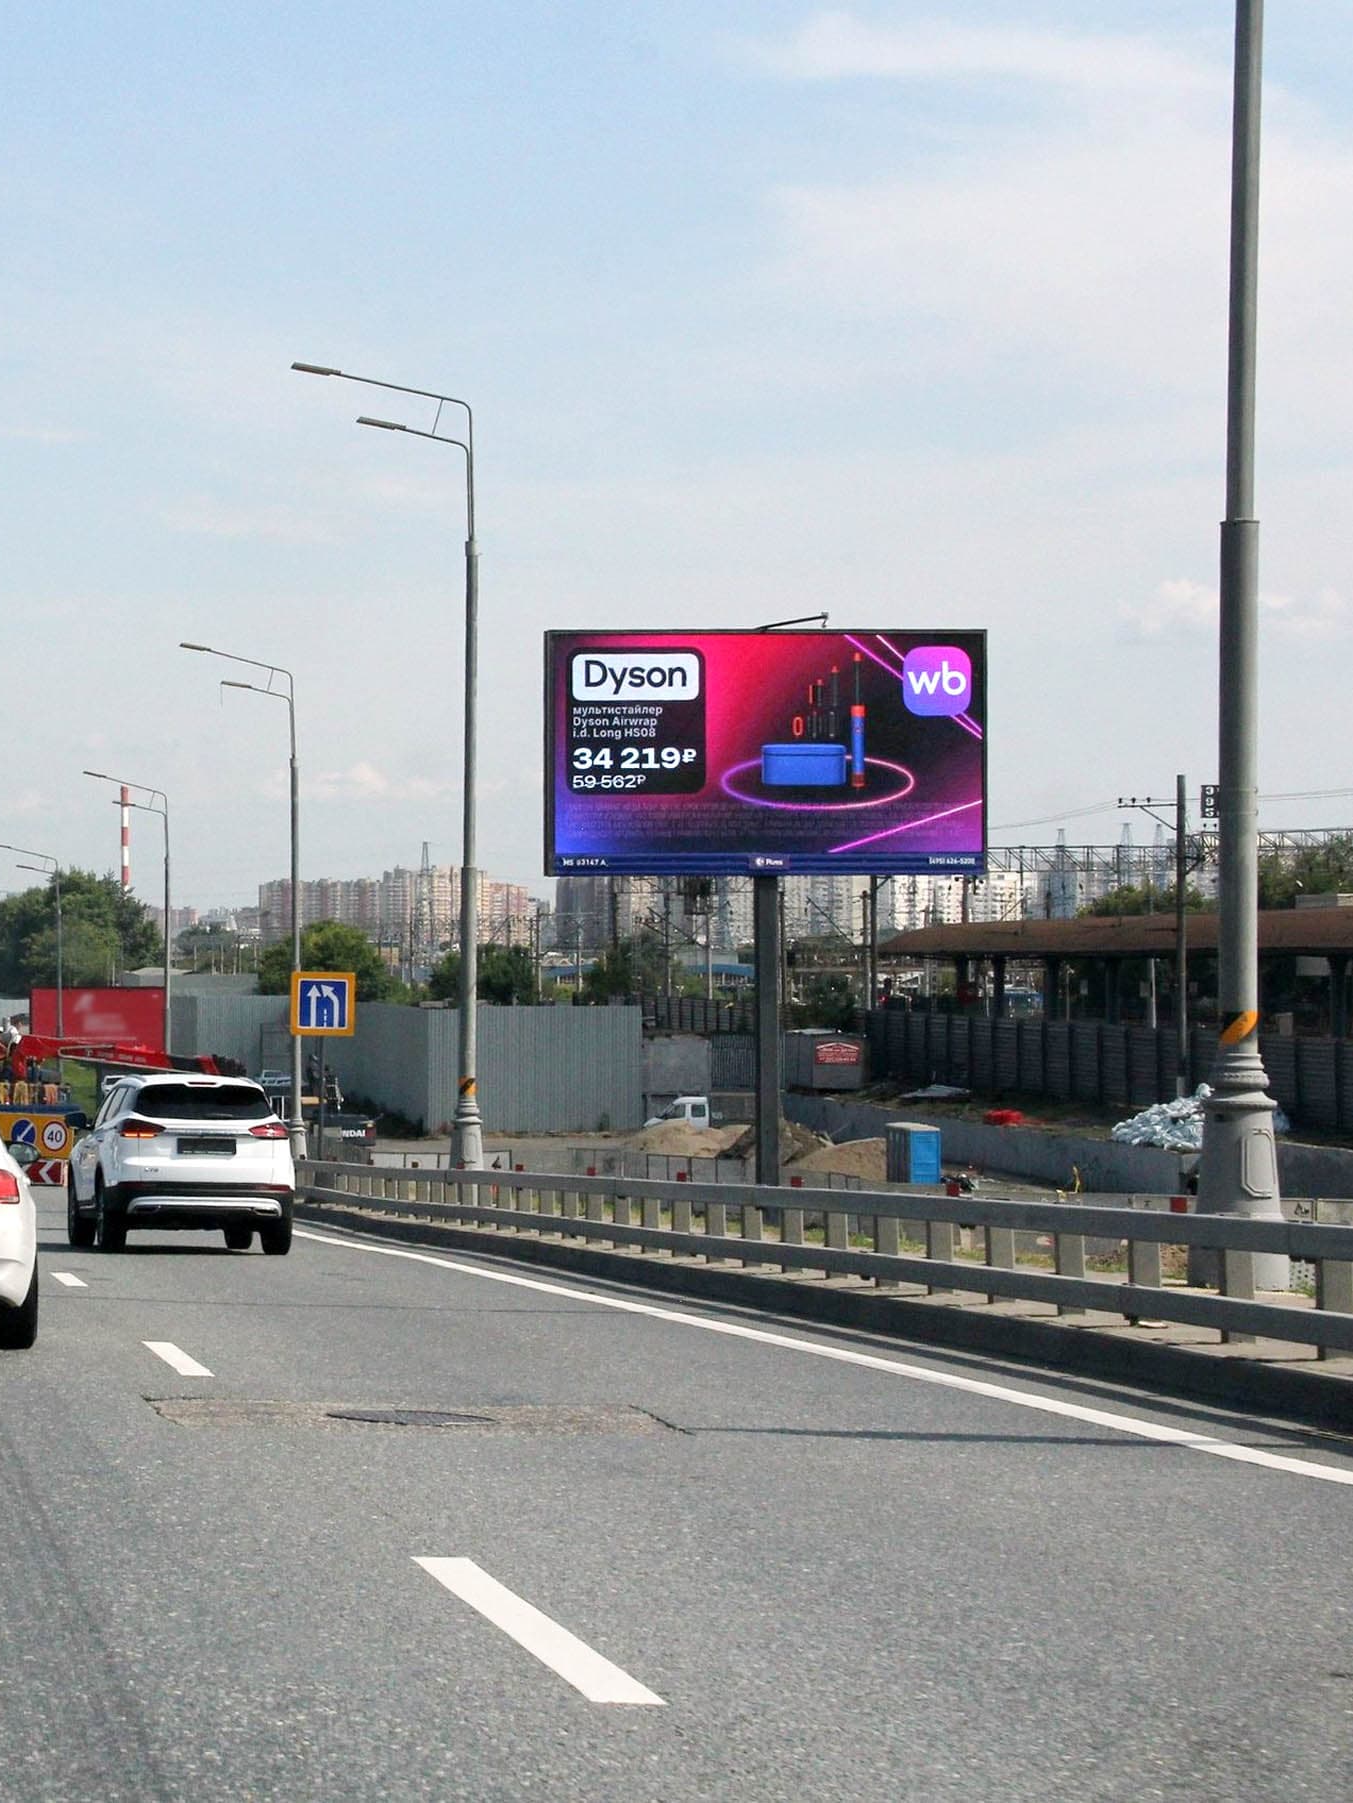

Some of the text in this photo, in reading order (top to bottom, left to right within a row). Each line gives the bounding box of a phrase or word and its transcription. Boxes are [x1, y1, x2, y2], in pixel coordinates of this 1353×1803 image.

[584, 659, 687, 695] Dyson
[907, 660, 967, 696] wb
[572, 705, 663, 717] мультистайлер
[572, 716, 658, 729] Dyson Airwrap
[572, 728, 656, 740] i.d. Long HS08
[572, 747, 614, 770] 34
[47, 1130, 63, 1143] 40
[342, 1129, 366, 1137] NDAI
